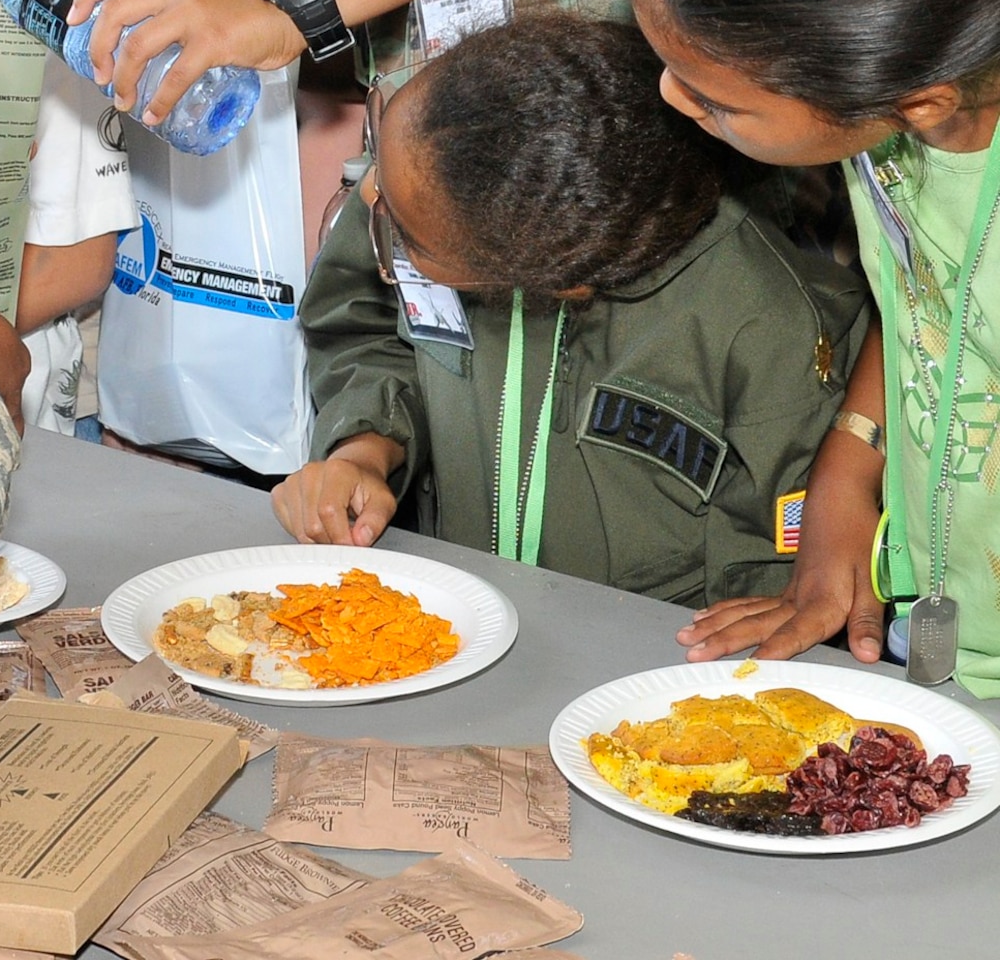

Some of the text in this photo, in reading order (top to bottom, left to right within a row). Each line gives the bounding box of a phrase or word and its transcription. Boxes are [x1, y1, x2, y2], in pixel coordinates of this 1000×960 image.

[95, 160, 128, 178] WAVE
[175, 253, 217, 268] EMERGENCY
[202, 272, 282, 300] MANAGEMENT
[205, 292, 237, 308] Respond
[246, 299, 279, 315] Recover
[593, 391, 720, 480] USAF
[392, 801, 410, 809] Cake
[476, 809, 500, 818] Lemon
[422, 810, 469, 838] Pangea
[380, 903, 422, 931] COFFEE
